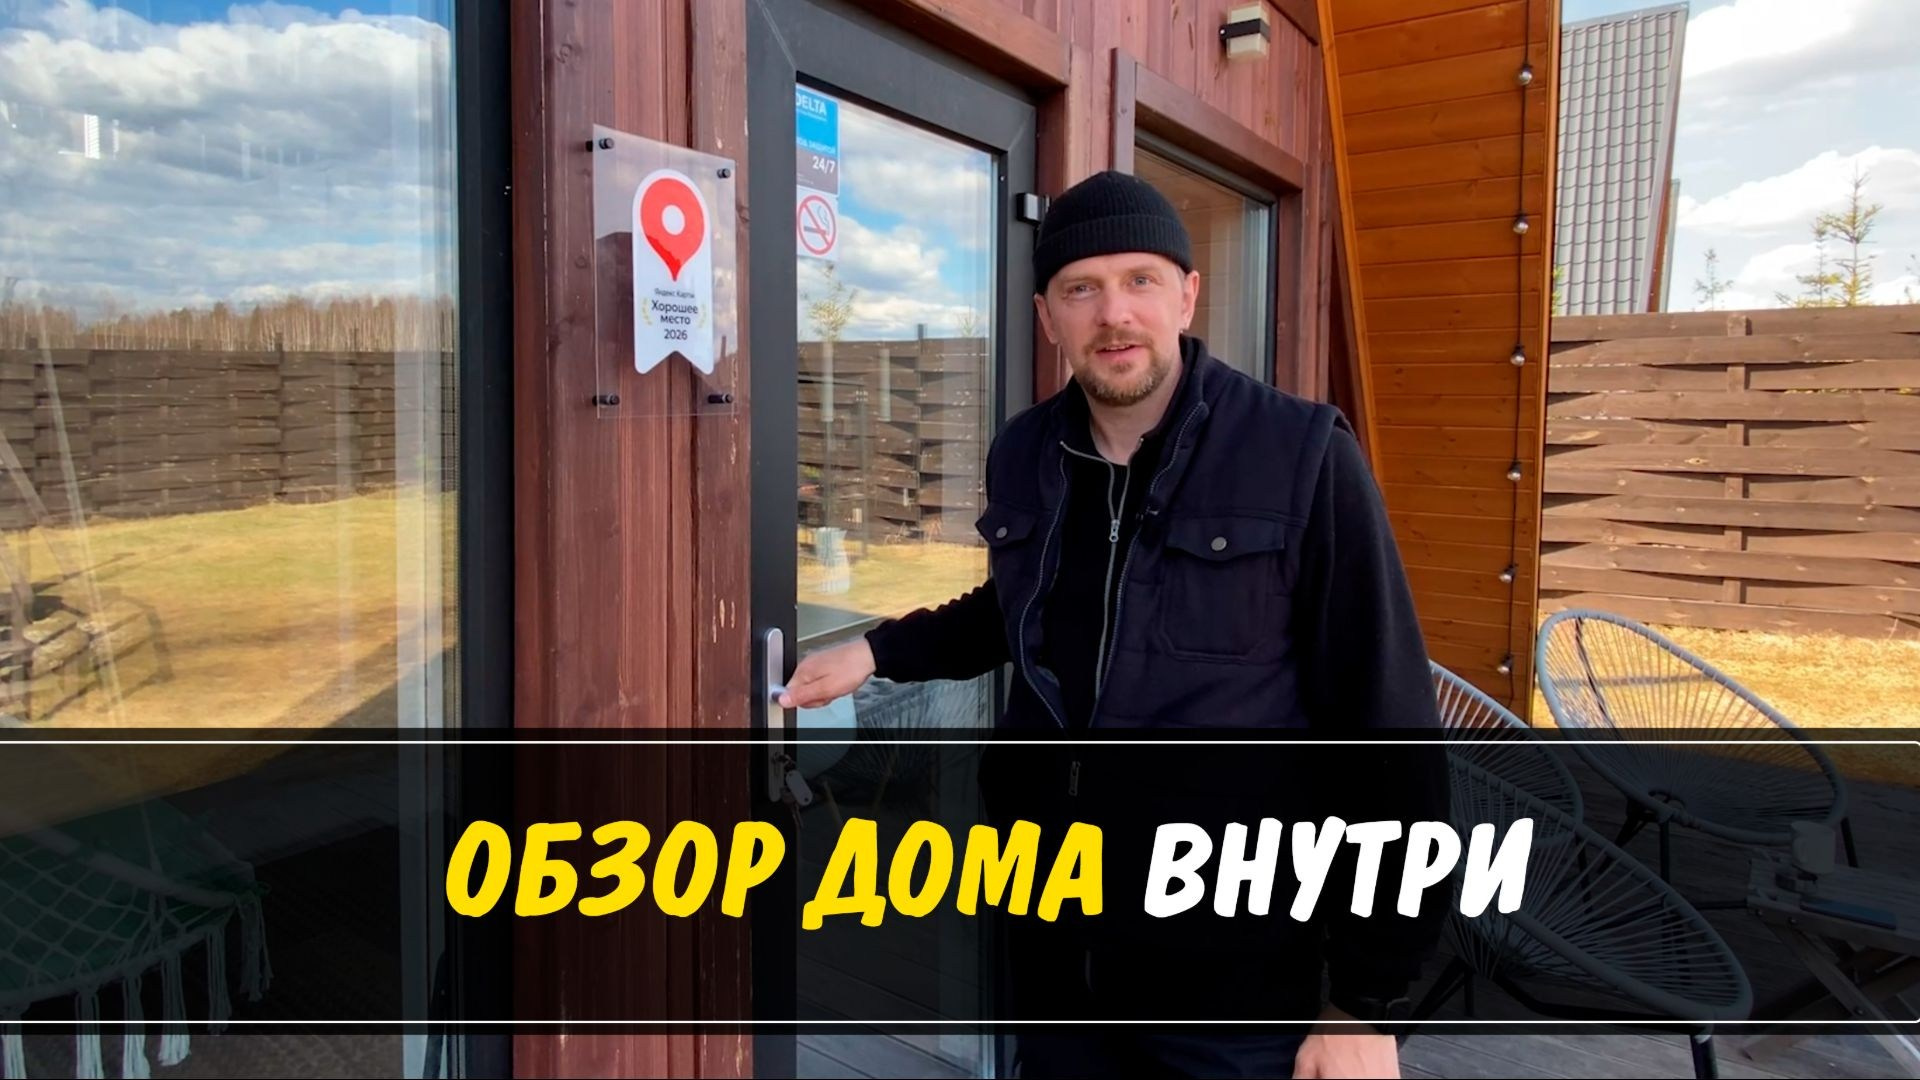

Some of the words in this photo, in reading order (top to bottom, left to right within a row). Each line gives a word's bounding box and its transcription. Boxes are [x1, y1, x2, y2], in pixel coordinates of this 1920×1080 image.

[812, 155, 836, 174] 24/7
[651, 299, 698, 314] Хорошее
[660, 314, 691, 325] место
[664, 328, 688, 341] 2026
